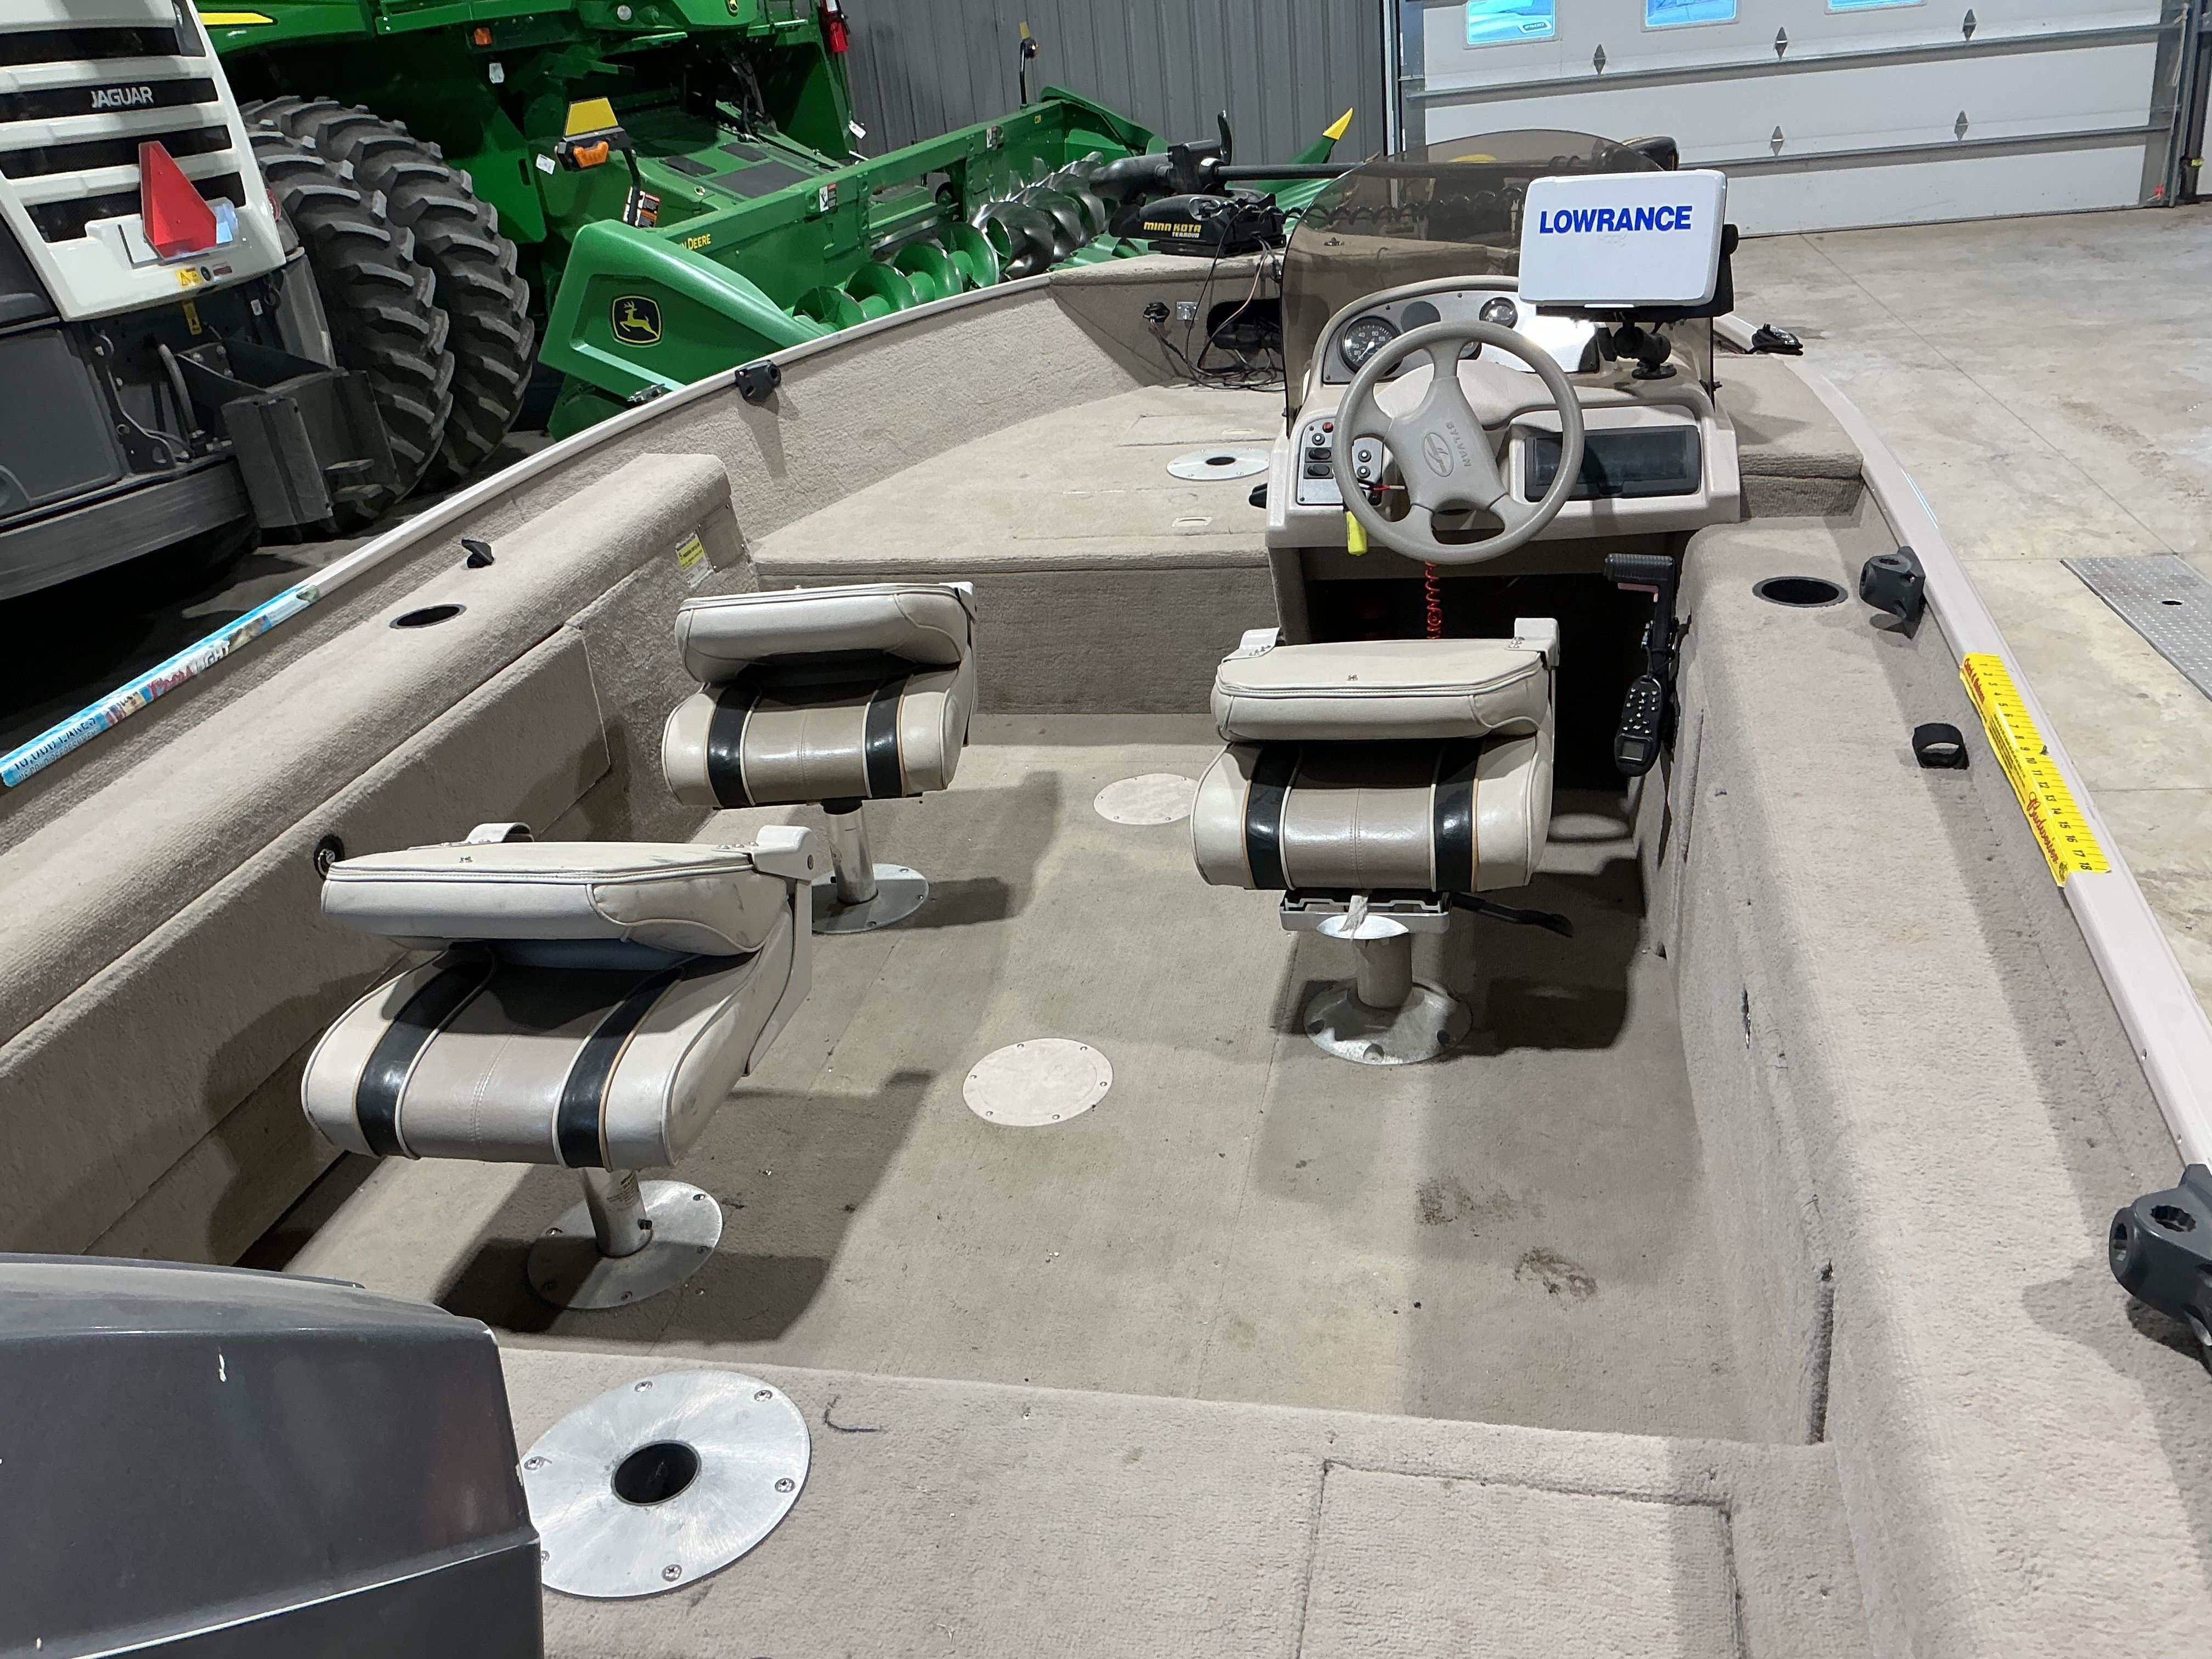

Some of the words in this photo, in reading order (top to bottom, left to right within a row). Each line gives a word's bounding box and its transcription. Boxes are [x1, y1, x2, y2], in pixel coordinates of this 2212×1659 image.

[91, 86, 154, 108] JAGUAR
[1143, 222, 1172, 232] MINN
[1173, 223, 1201, 233] KOTA
[1539, 206, 1692, 234] LOWRANCE
[687, 233, 712, 250] DEERE
[1446, 421, 1471, 467] SYLVAN
[2027, 792, 2059, 864] Budweiser
[2079, 862, 2092, 871] 18
